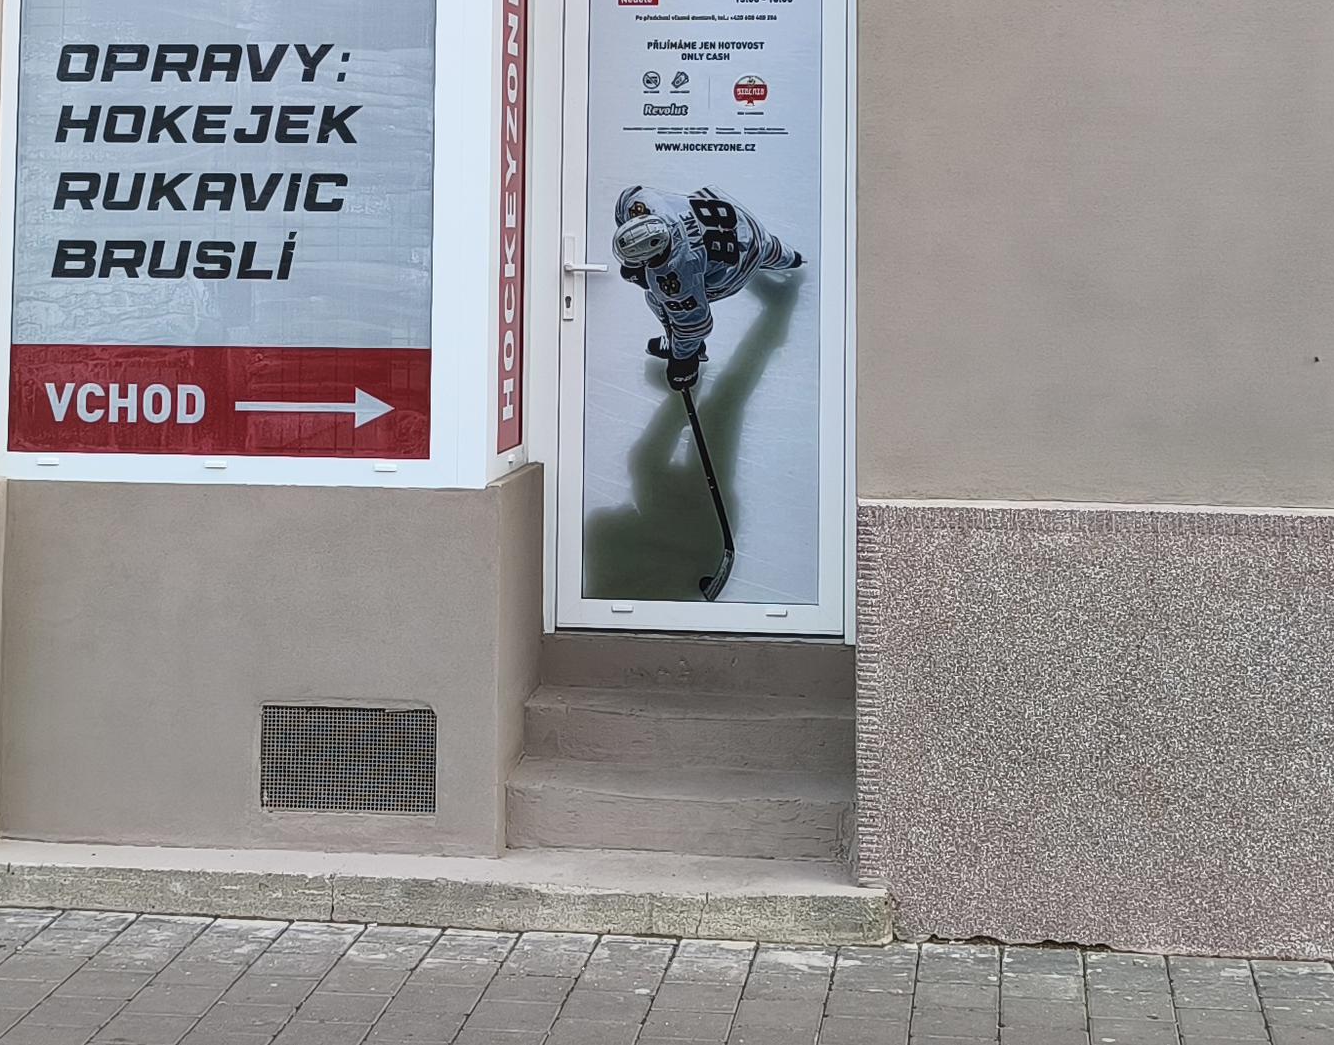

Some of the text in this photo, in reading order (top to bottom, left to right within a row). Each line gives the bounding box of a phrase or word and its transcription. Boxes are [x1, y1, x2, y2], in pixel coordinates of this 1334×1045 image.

[54, 42, 352, 83] OPRAVY:
[647, 39, 765, 50] PŘIJÍMÁME JEN HOTOVOST
[681, 52, 730, 61] ONLY CASH
[53, 104, 365, 144] HOKEJEK
[643, 103, 689, 116] Revolut
[655, 142, 756, 152] WWW.HOCKEYZONE.CZ
[52, 172, 350, 212] RUKAVIC
[679, 210, 704, 250] KANE
[50, 231, 298, 280] BRUSLÍ
[44, 382, 208, 425] VCHOD
